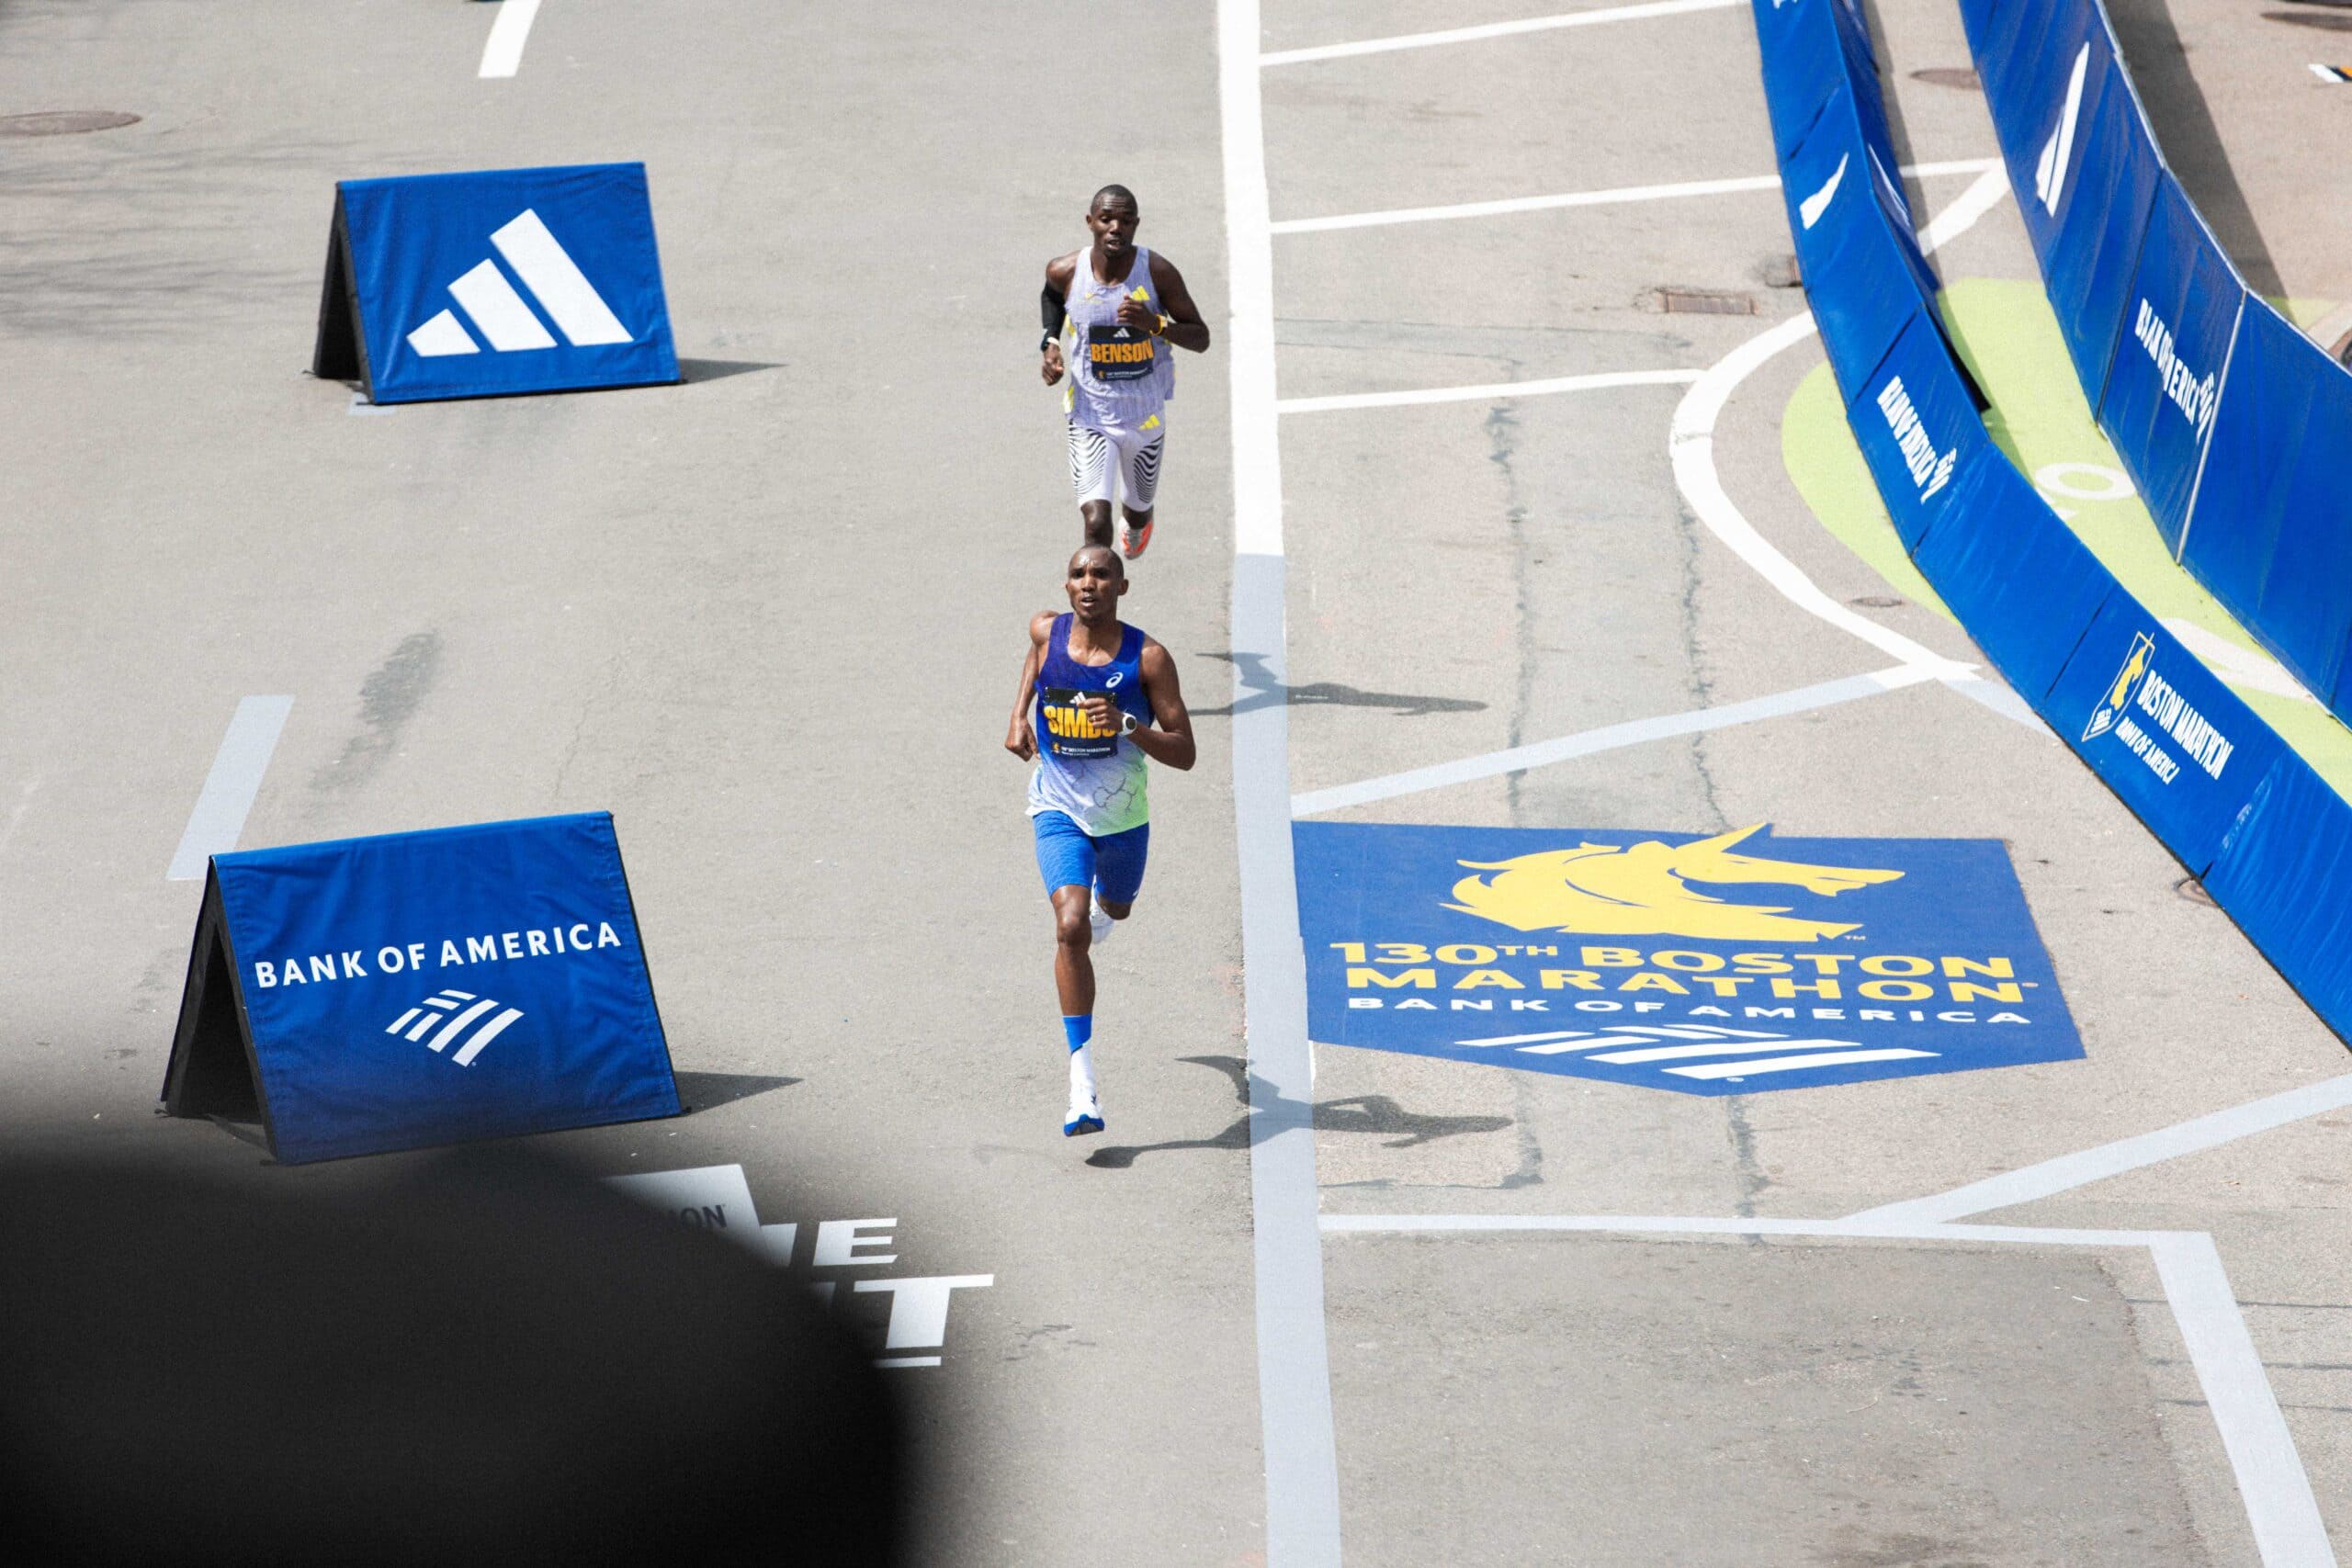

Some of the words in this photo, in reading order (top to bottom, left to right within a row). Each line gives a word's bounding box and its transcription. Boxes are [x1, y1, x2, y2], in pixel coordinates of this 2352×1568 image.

[1091, 339, 1154, 364] BENSON
[1044, 705, 1115, 739] SIM
[2114, 716, 2144, 749] BANK
[2136, 669, 2185, 734] BOSTON
[2171, 702, 2234, 781] MARATHON
[2132, 734, 2153, 757] OF
[2142, 743, 2181, 785] AMERICA
[254, 950, 368, 988] BANK
[378, 942, 426, 975] OF
[440, 921, 622, 967] AMERICA
[1329, 942, 1558, 964] 130TH
[1579, 945, 2015, 978] BOSTON
[1345, 967, 2024, 1003] MARATHON
[1348, 997, 1551, 1011] BANK
[1574, 999, 1666, 1013] OF
[1688, 1005, 2031, 1024] AMERICA
